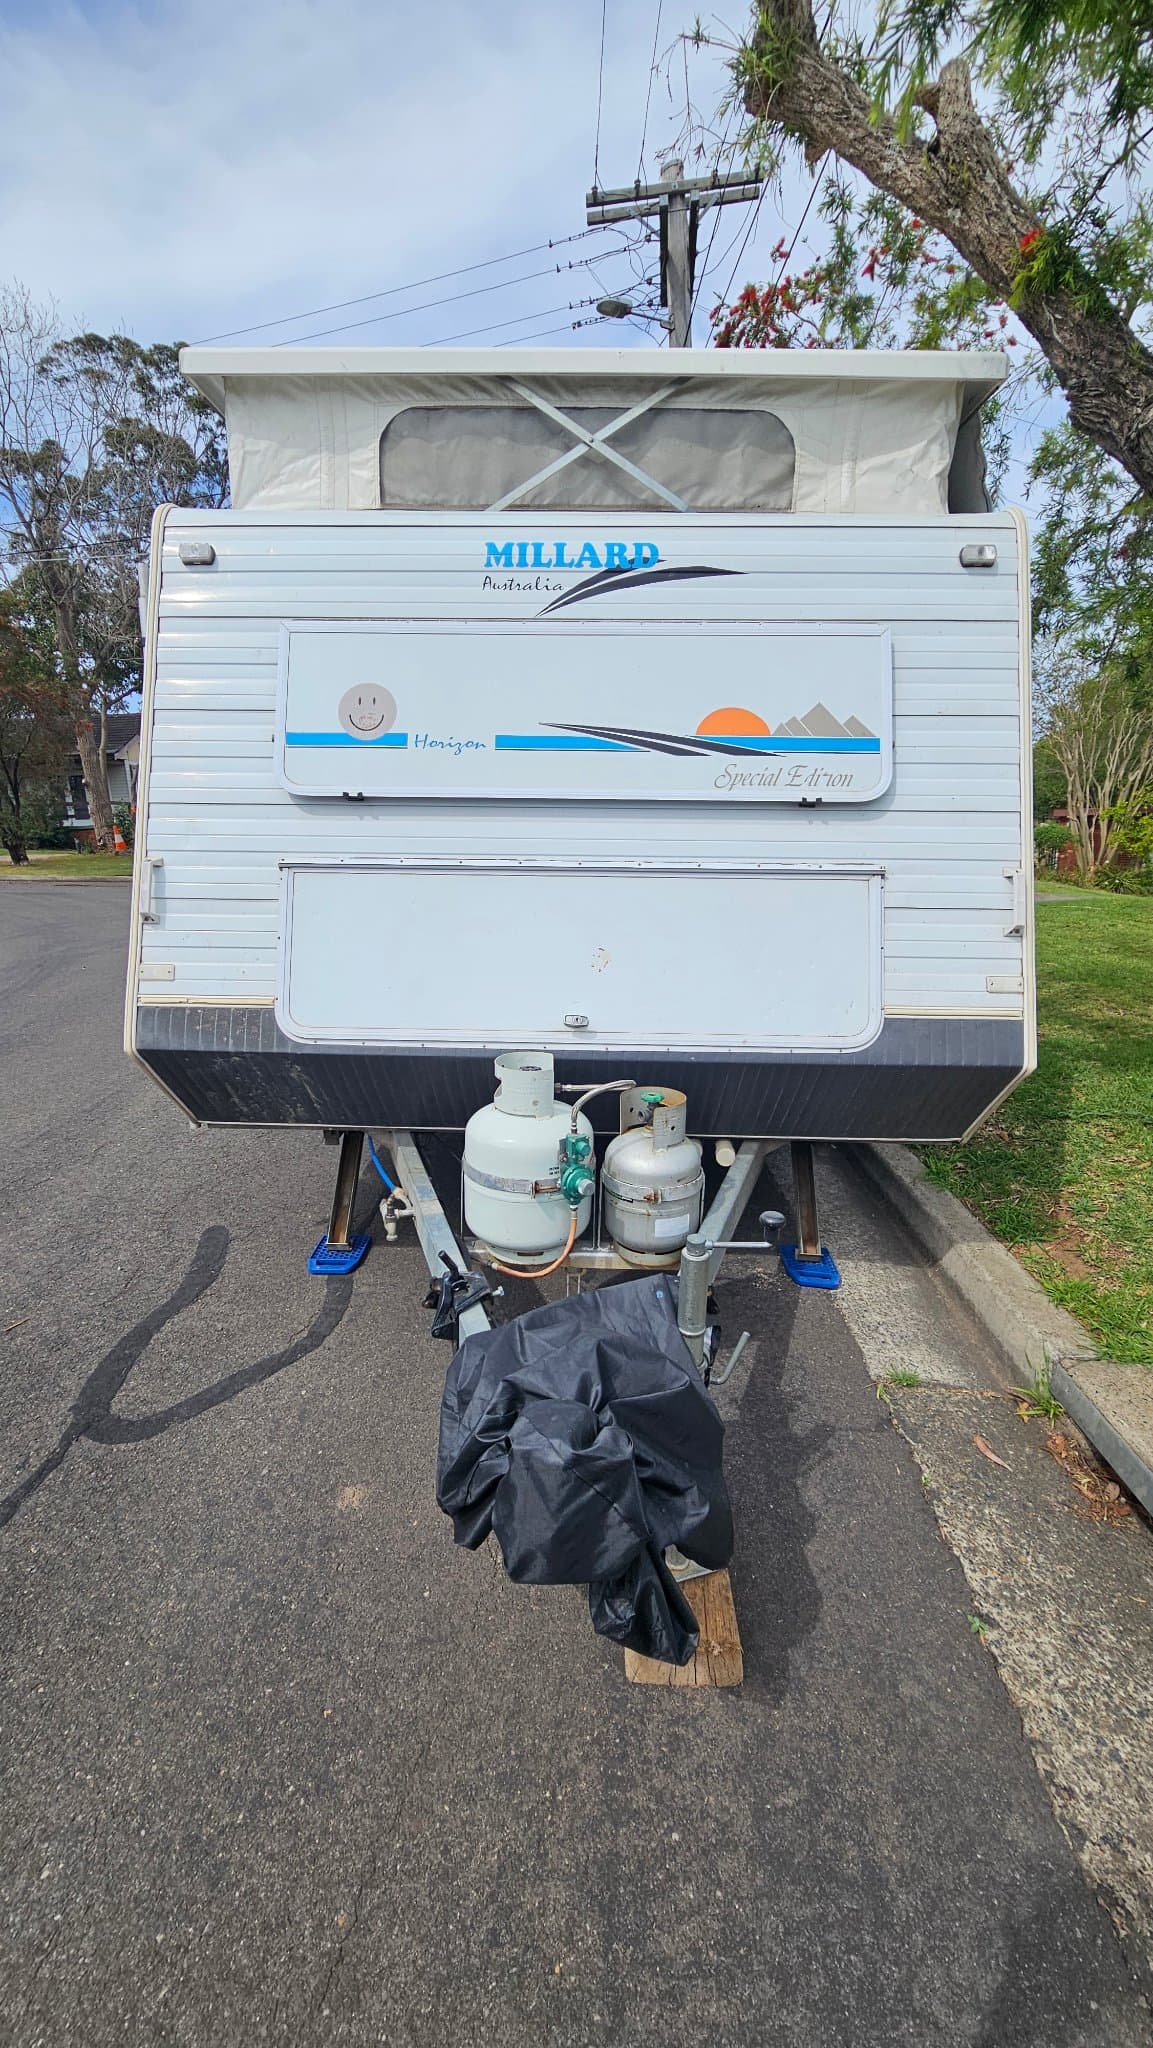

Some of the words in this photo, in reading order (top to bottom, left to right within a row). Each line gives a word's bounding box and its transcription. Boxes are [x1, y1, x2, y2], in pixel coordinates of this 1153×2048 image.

[484, 542, 660, 569] MILLARD
[482, 575, 564, 592] Australia
[414, 733, 487, 755] Horizon
[714, 763, 783, 792] Special
